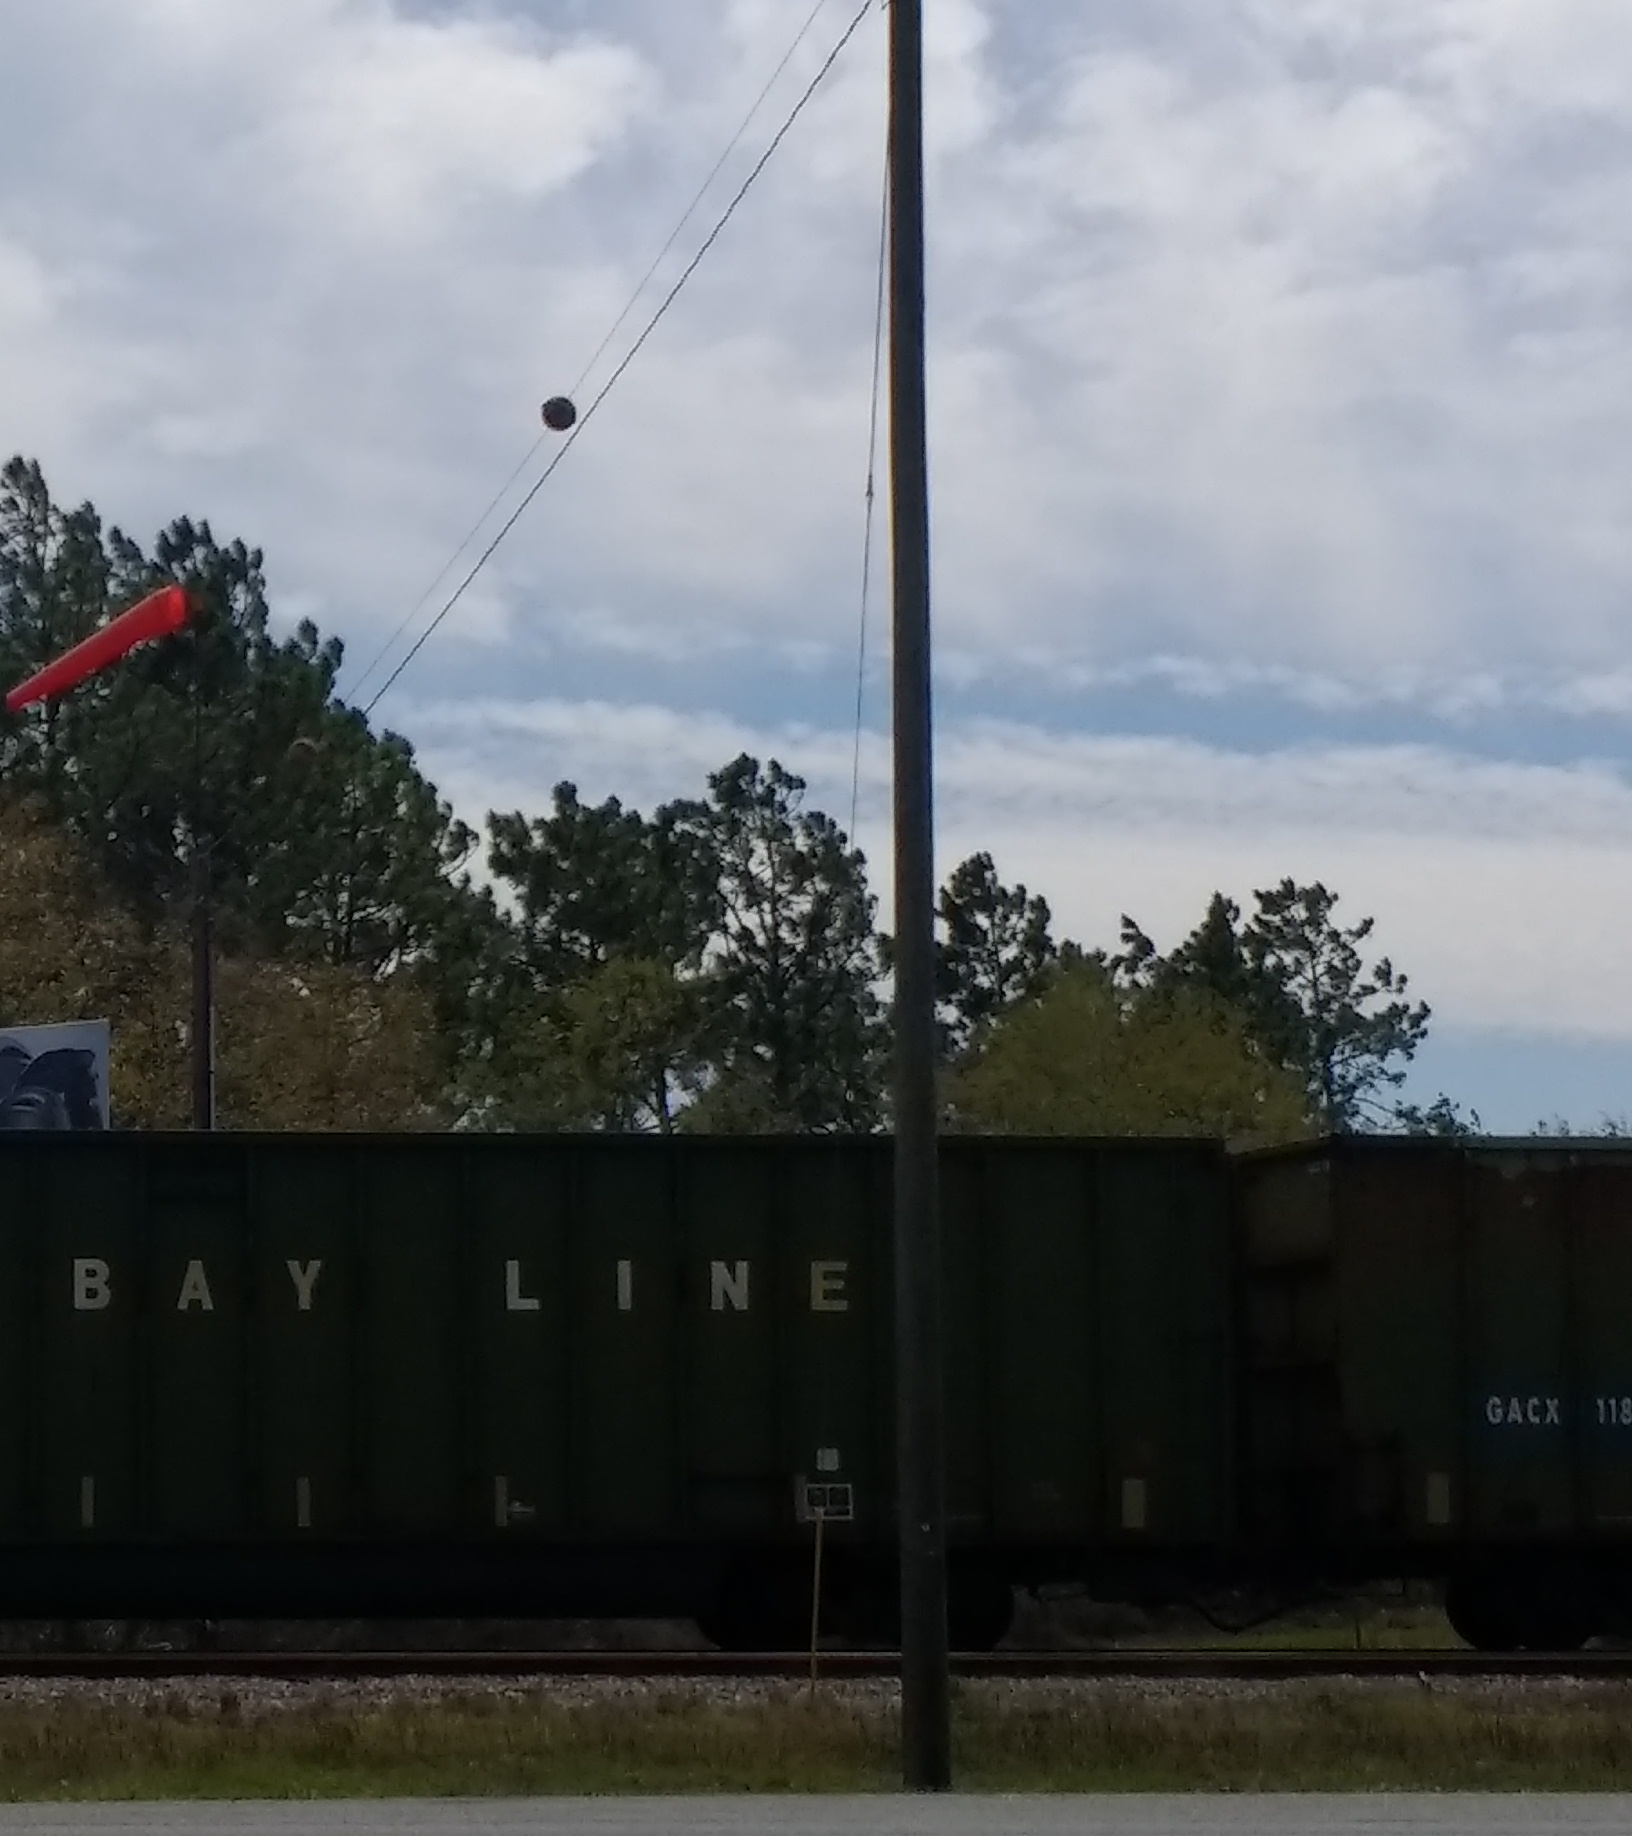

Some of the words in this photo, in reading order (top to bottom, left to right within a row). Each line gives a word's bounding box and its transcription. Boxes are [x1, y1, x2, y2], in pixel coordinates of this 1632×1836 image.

[73, 1258, 322, 1311] BAY
[504, 1259, 850, 1311] LINE
[1486, 1396, 1559, 1424] GACX
